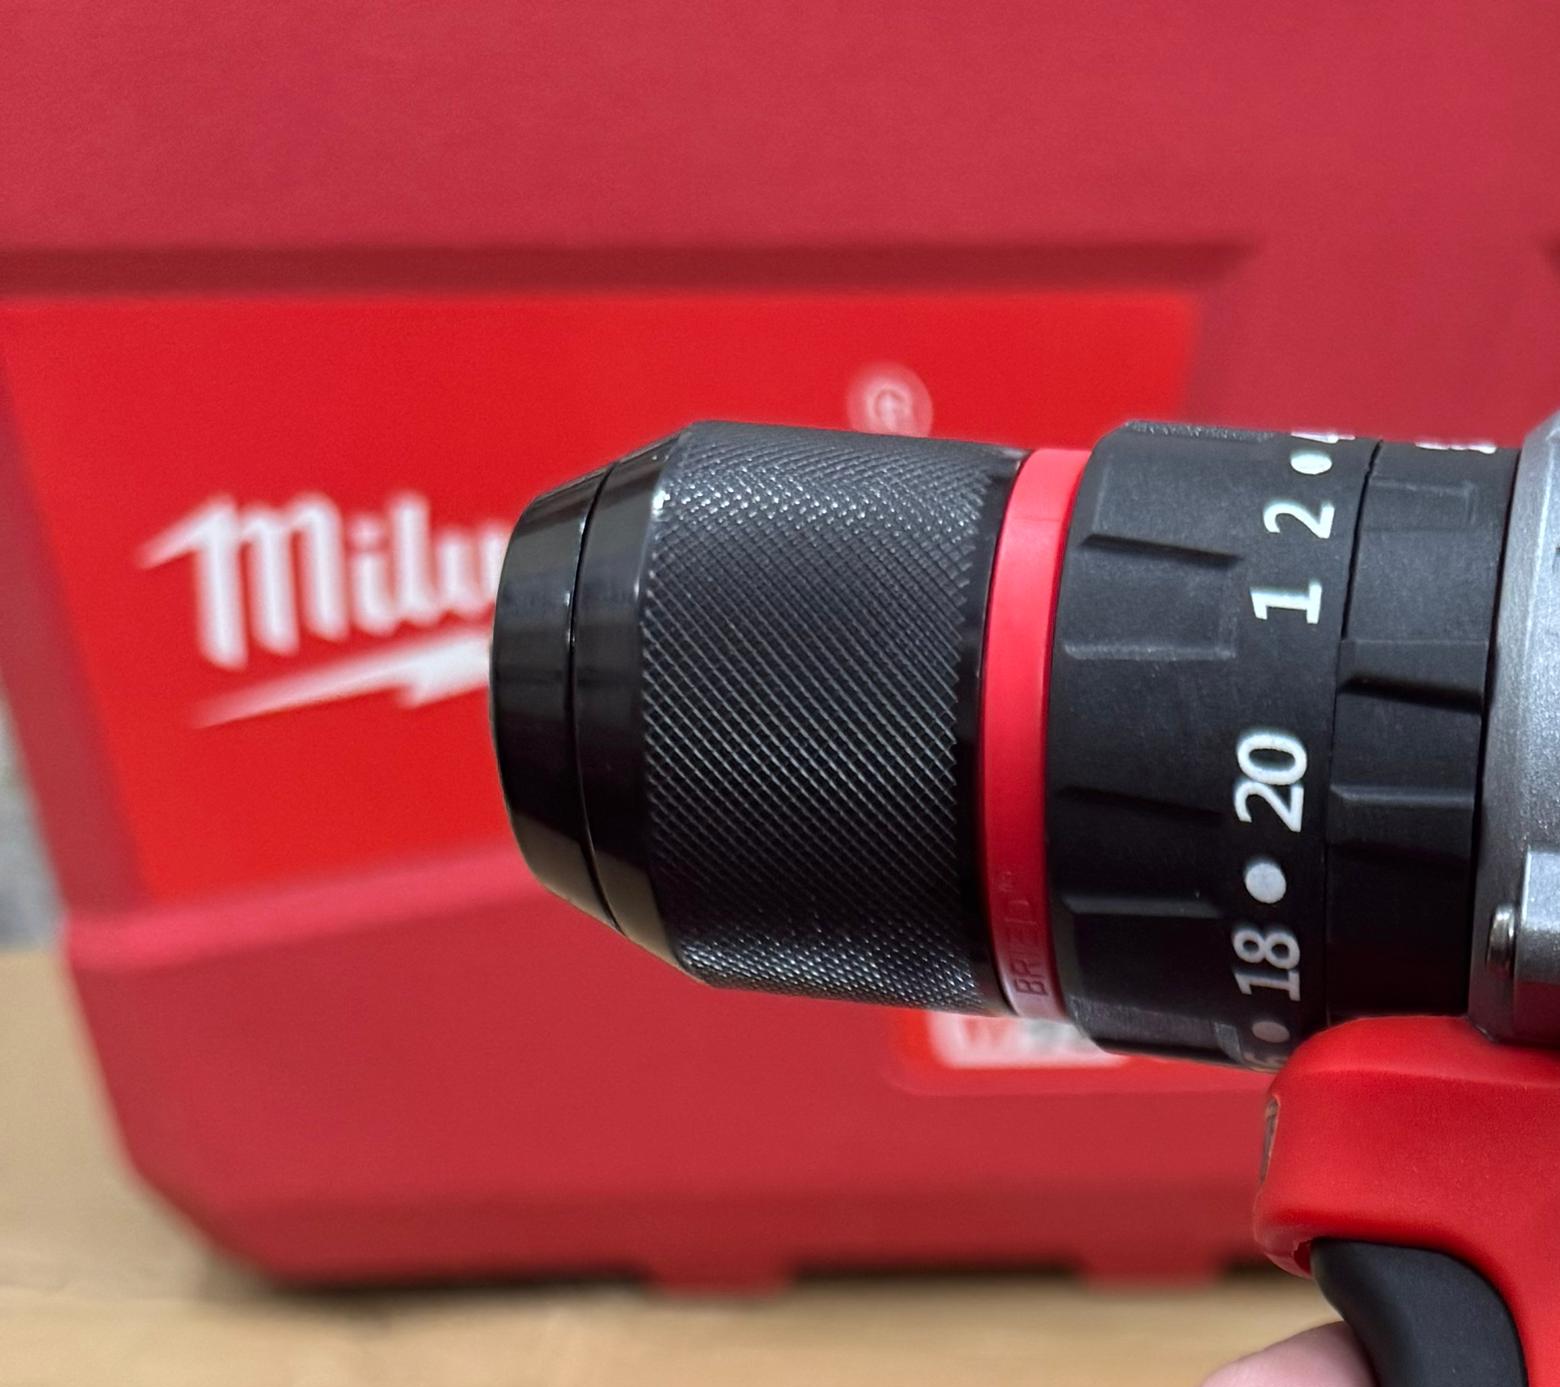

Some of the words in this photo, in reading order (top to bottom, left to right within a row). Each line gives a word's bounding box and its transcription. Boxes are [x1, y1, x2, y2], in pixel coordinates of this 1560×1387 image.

[1262, 498, 1336, 540] 2
[1249, 582, 1324, 625] 1
[1233, 732, 1309, 834] 20
[1232, 924, 1302, 1002] 18
